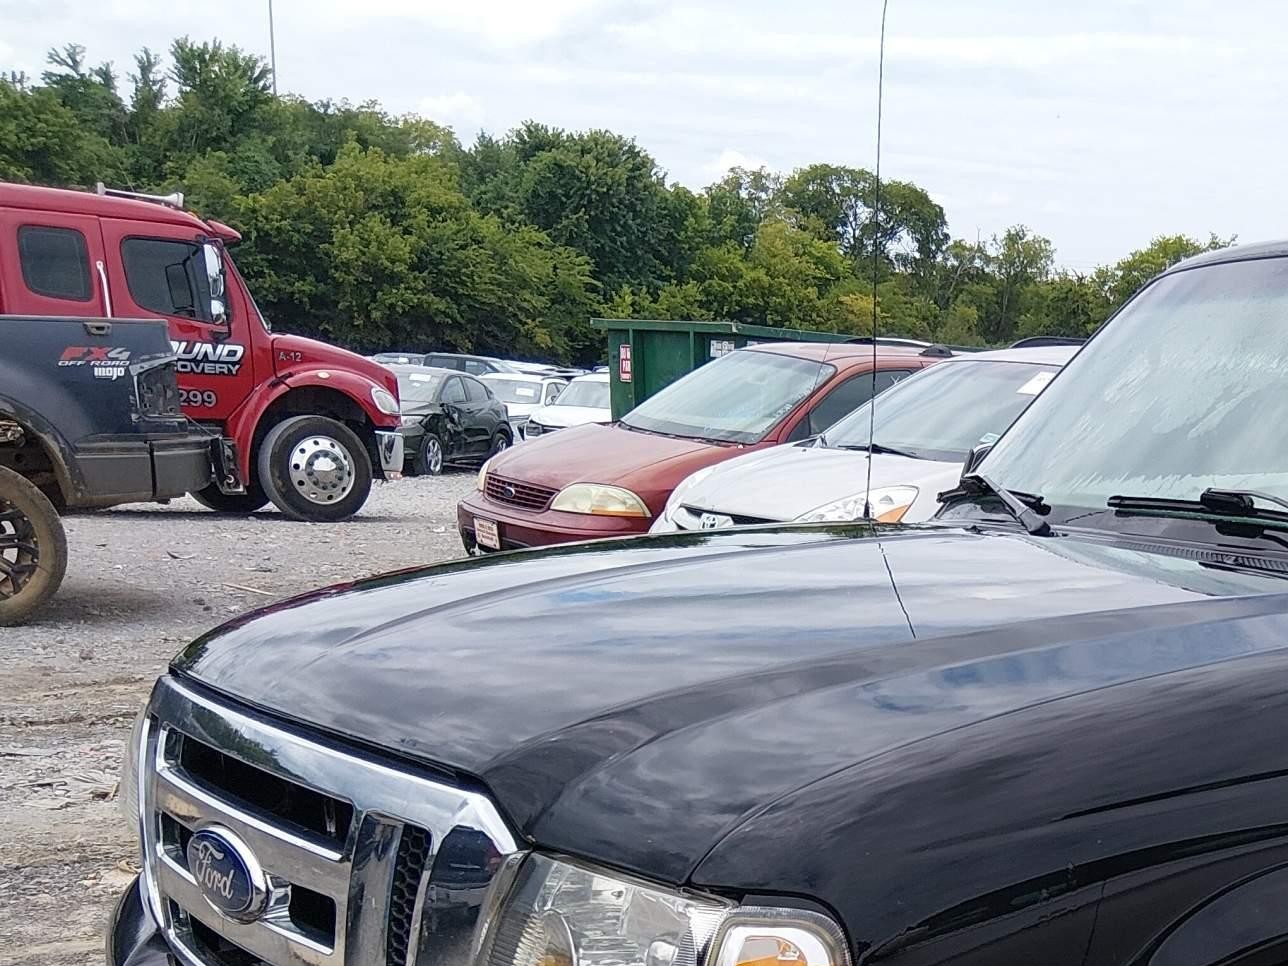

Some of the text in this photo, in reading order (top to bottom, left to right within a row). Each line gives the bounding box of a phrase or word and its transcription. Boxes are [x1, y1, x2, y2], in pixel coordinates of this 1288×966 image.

[59, 346, 132, 360] FX4
[279, 352, 302, 362] A-12
[192, 841, 235, 899] Ford
